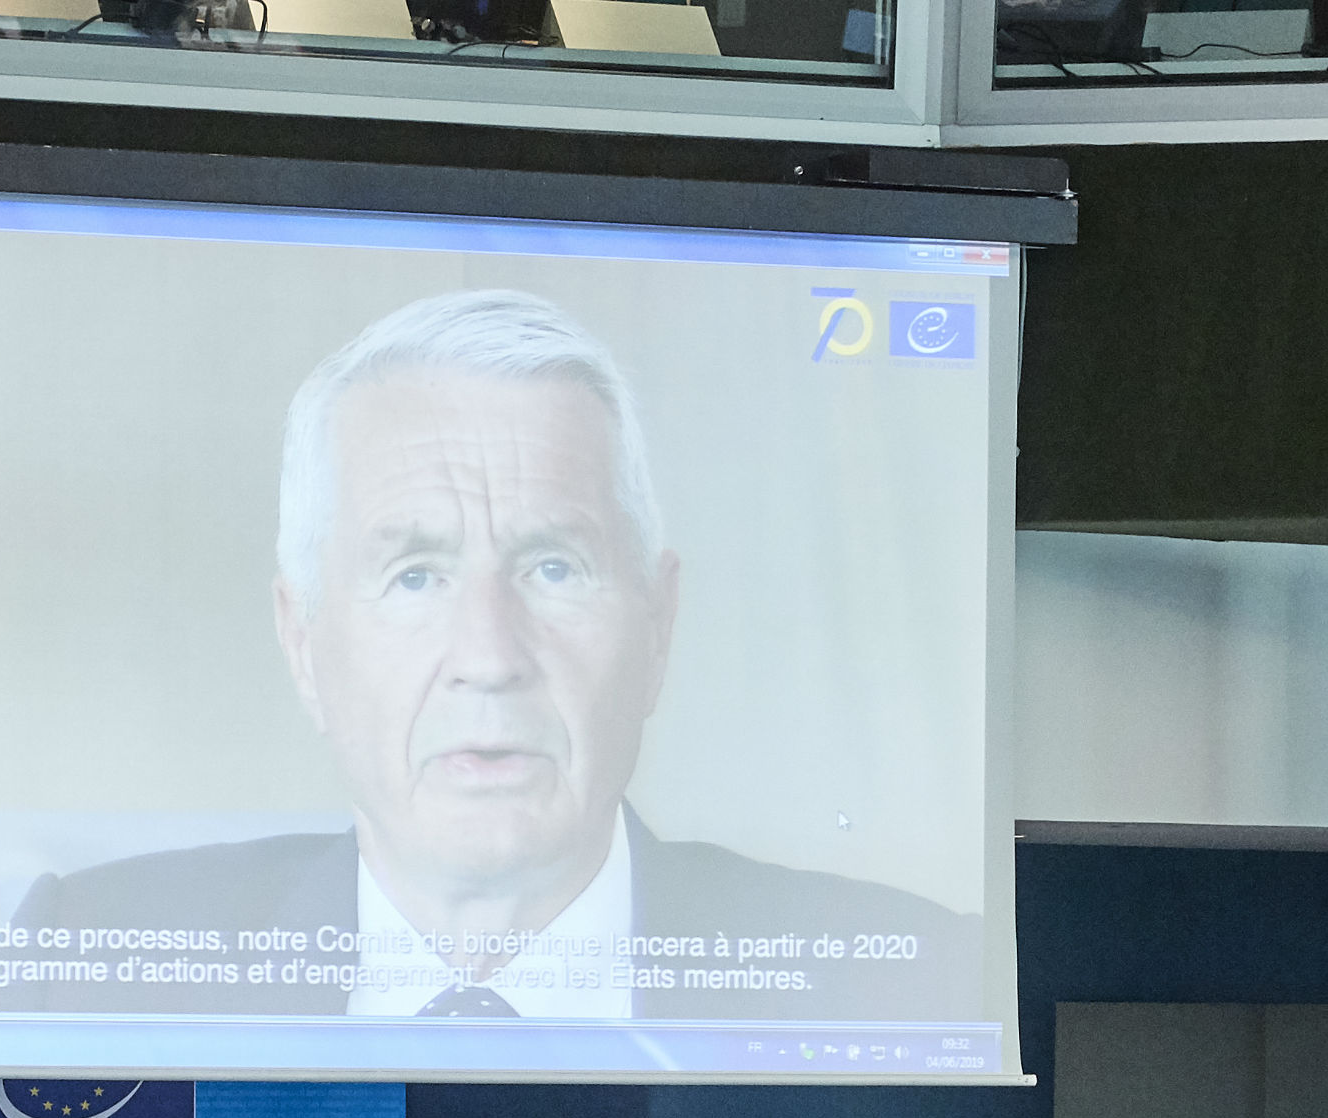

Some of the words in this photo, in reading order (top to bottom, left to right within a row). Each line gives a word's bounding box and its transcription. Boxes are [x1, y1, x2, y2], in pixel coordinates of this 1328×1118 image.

[37, 928, 71, 949] ce
[79, 928, 229, 956] processus,
[237, 925, 308, 952] notre
[316, 926, 413, 954] Comité
[422, 928, 456, 955] de
[463, 928, 602, 962] bioéthique
[609, 931, 706, 958] lancera
[713, 931, 731, 957] à
[738, 933, 805, 963] partir
[812, 933, 845, 959] de
[852, 934, 917, 960] 2020
[116, 956, 240, 984] d'actions
[247, 960, 275, 984] et
[491, 966, 555, 988] avec
[562, 963, 600, 989] les
[609, 957, 676, 990] États
[683, 963, 813, 991] membres.
[941, 1037, 970, 1050] 09:32
[925, 1056, 985, 1069] 04/06/2019
